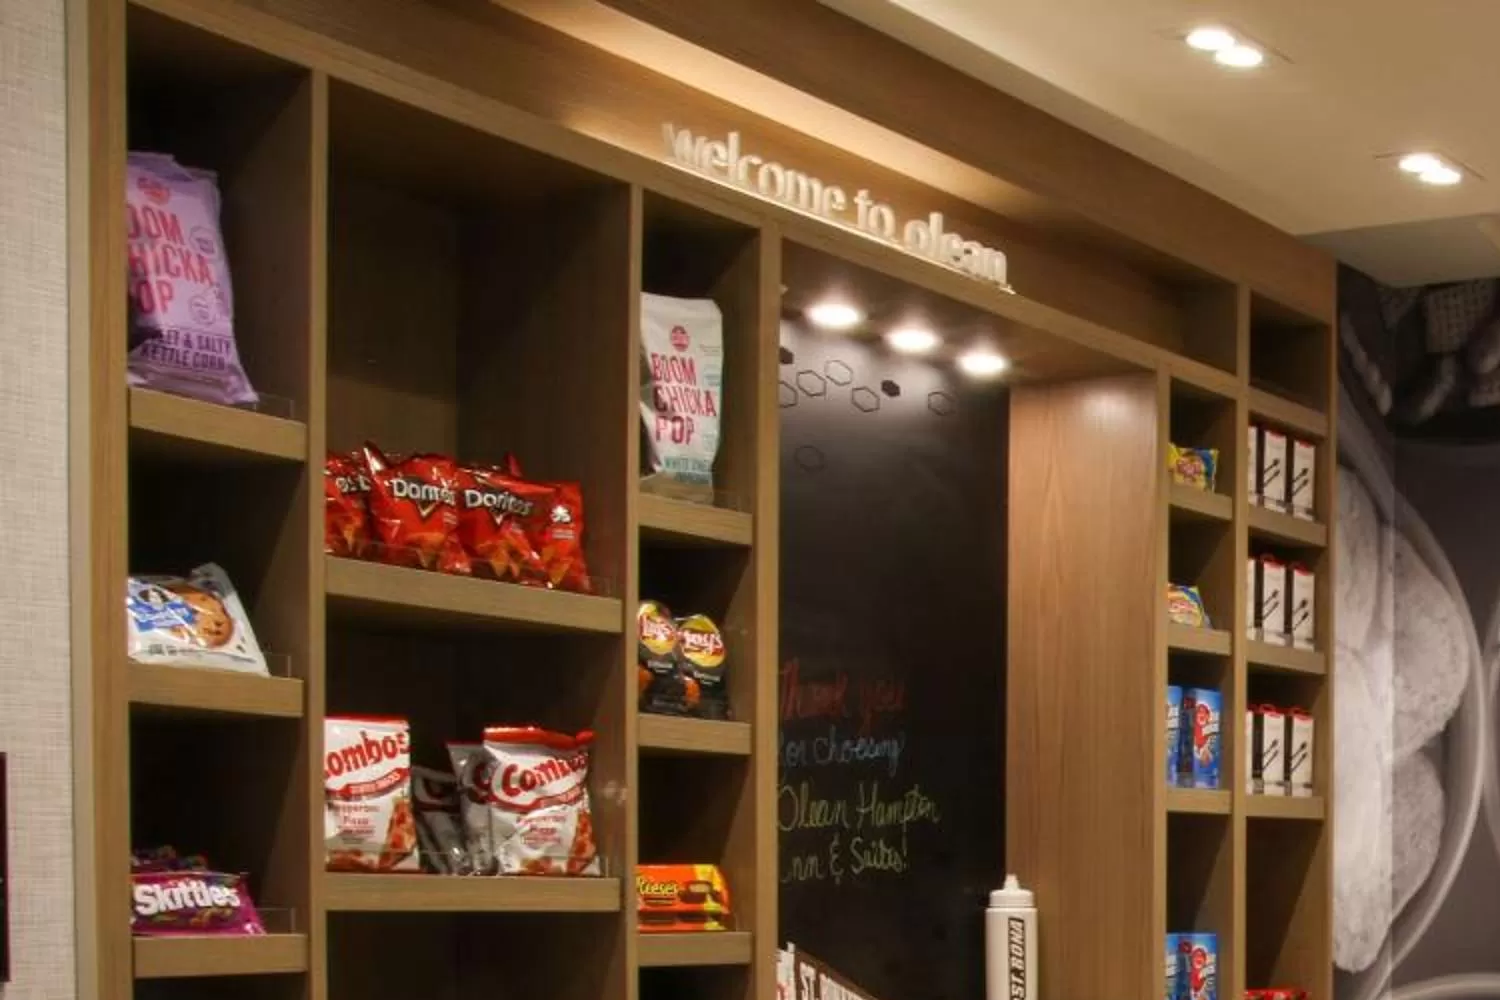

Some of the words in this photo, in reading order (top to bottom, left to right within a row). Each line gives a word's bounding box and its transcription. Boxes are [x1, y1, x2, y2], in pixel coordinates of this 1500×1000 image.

[661, 122, 847, 218] welcome
[854, 188, 897, 241] to
[905, 211, 1009, 287] olean
[127, 203, 184, 246] OOM
[127, 243, 216, 287] HICKA
[135, 278, 174, 316] OP
[650, 351, 698, 387] BOOM
[652, 383, 717, 418] CHICKA
[655, 415, 695, 446] POP
[465, 487, 533, 517] Doritos
[324, 730, 409, 780] ombos
[133, 878, 241, 916] Skittles
